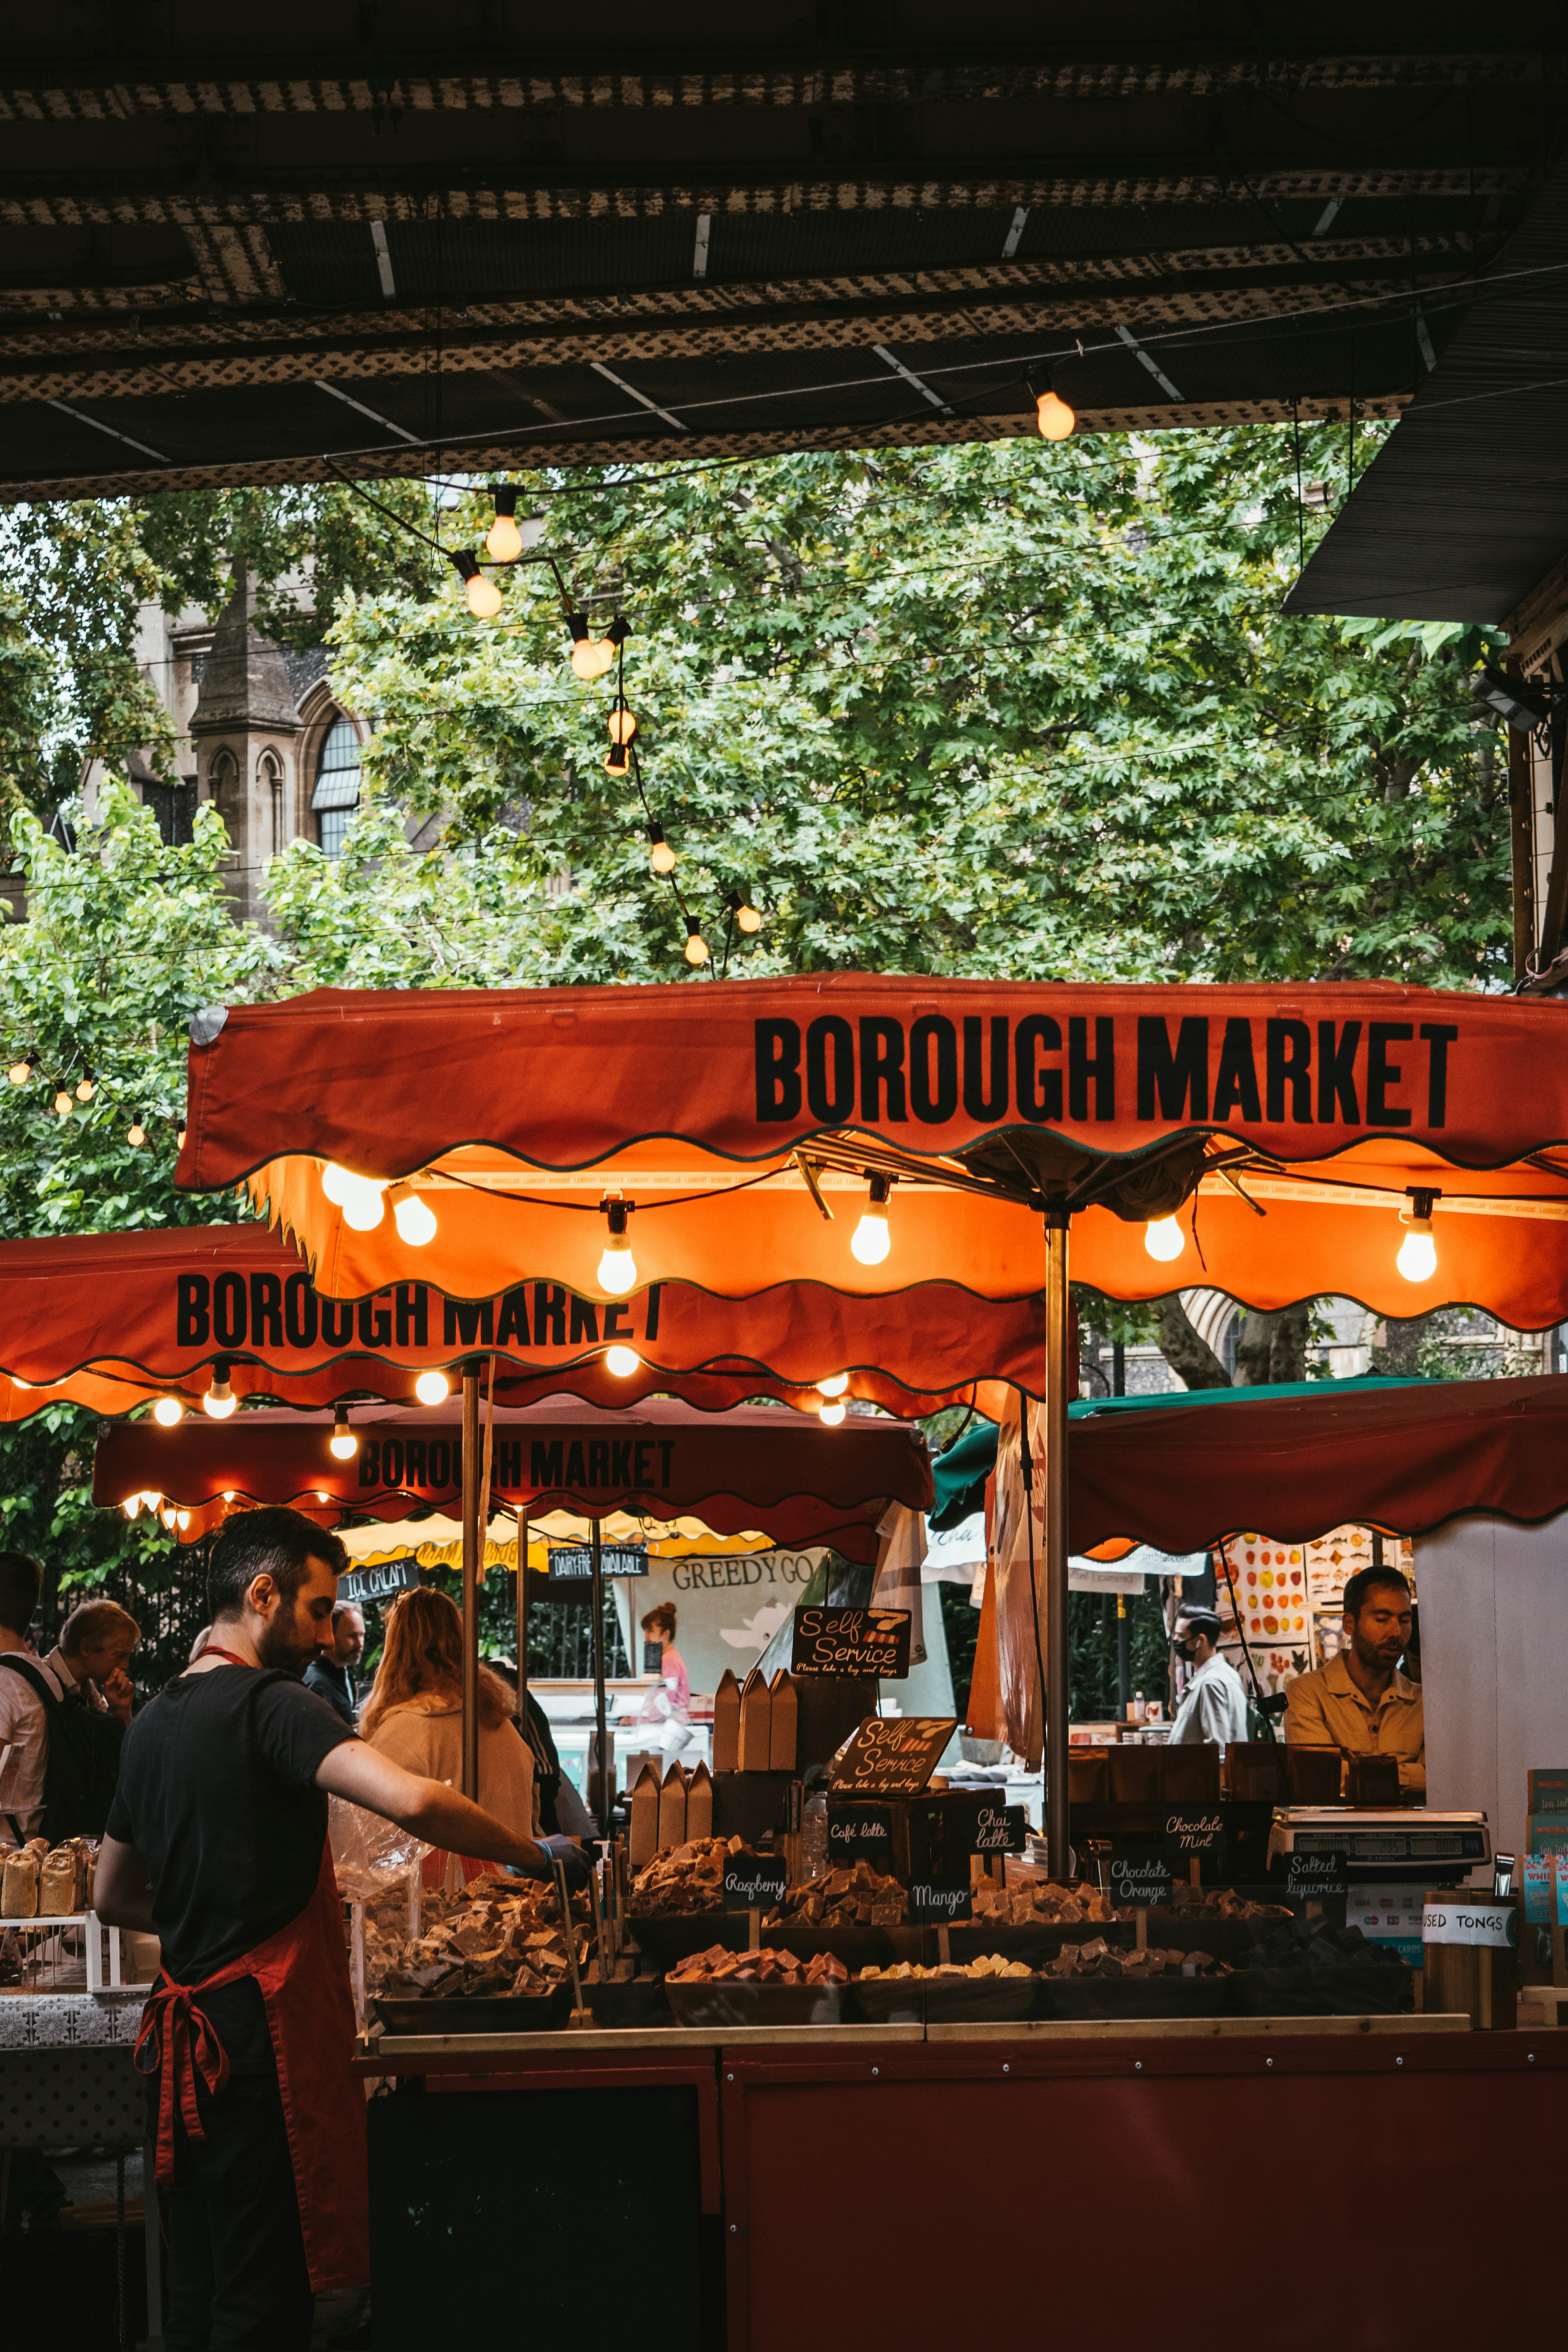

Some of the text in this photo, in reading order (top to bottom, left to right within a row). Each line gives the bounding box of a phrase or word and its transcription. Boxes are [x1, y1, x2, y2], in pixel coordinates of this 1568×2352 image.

[755, 1014, 1458, 1128] BOROUGH MARKET
[177, 1272, 428, 1348] BOROUGH
[531, 1440, 674, 1488] MARKET
[673, 1556, 776, 1590] GREEDY
[799, 1610, 863, 1644] Self
[812, 1637, 897, 1664] Service
[796, 1662, 819, 1672] Please
[848, 1664, 860, 1676] bag
[857, 1720, 915, 1751] Self
[855, 1748, 926, 1776] Service
[833, 1778, 853, 1790] Please
[878, 1778, 889, 1793] bag
[890, 1778, 906, 1788] and
[978, 1809, 1011, 1827] Chai
[1166, 1815, 1223, 1834] Chocolate
[831, 1822, 887, 1843] Café latte
[975, 1827, 1015, 1849] latte
[1112, 1860, 1170, 1878] Chocolate
[1291, 1855, 1337, 1874] Salted
[725, 1873, 786, 1901] Raspberry
[1120, 1879, 1167, 1905] Orange
[1286, 1873, 1344, 1900] liquorice
[913, 1885, 968, 1916] Mango
[1423, 1914, 1502, 1931] USED TONGS
[1398, 1945, 1421, 1954] CARDS
